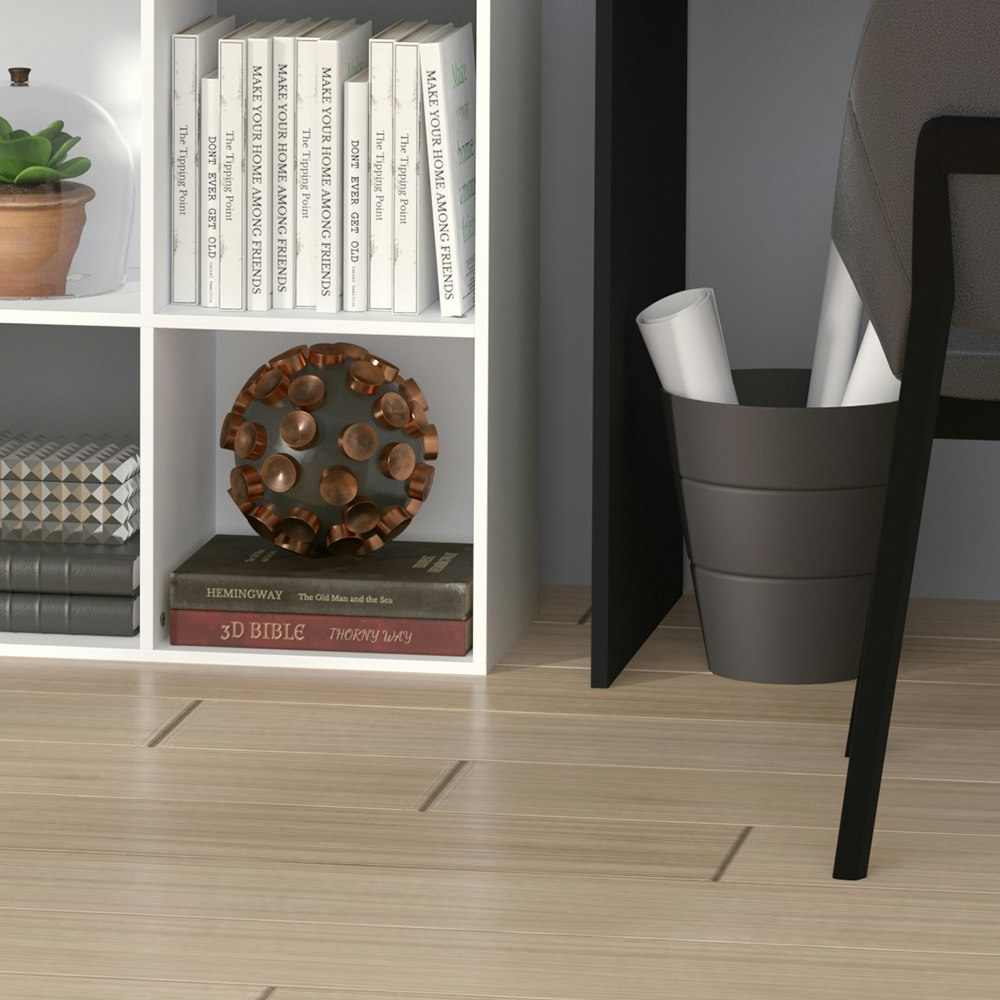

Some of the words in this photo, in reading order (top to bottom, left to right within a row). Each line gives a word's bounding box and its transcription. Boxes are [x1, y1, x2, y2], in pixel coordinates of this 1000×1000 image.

[252, 66, 263, 103] MAKE
[278, 64, 288, 101] MAKE
[321, 67, 332, 104] MAKE
[426, 70, 439, 107] MAKE
[179, 125, 188, 145] The
[251, 105, 262, 142] YOUR
[277, 103, 288, 140] YOUR
[302, 128, 311, 148] The
[321, 106, 332, 143] YOUR
[376, 130, 385, 150] The
[430, 109, 442, 147] YOUR
[208, 136, 217, 165] DONT
[226, 131, 235, 150] The
[351, 140, 360, 169] DONT
[400, 134, 410, 154] The
[178, 147, 188, 188] Tipping
[223, 153, 234, 193] Tipping
[252, 144, 262, 185] HOME
[277, 142, 287, 183] HOME
[299, 151, 311, 191] Tipping
[321, 146, 332, 187] HOME
[373, 153, 385, 193] Tipping
[397, 156, 409, 197] Tipping
[433, 150, 446, 190] HOME
[179, 190, 188, 215] Point
[208, 172, 217, 201] EVER
[351, 176, 360, 205] EVER
[208, 208, 217, 230] GET
[226, 196, 234, 221] Point
[252, 187, 262, 237] AMONG
[277, 185, 287, 235] AMONG
[302, 194, 311, 219] Point
[321, 189, 331, 239] AMONG
[351, 212, 360, 234] GET
[376, 195, 384, 221] Point
[400, 199, 409, 225] Point
[436, 193, 450, 242] AMONG
[208, 237, 217, 259] OLD
[277, 238, 287, 293] FRIENDS
[351, 241, 360, 263] OLD
[251, 240, 262, 295] FRIENDS
[321, 242, 331, 297] FRIENDS
[441, 246, 454, 300] FRIENDS
[206, 587, 283, 600] HEMINGWAY
[298, 592, 314, 601] The
[315, 593, 330, 602] Old
[331, 594, 349, 603] Man
[350, 595, 365, 603] and
[366, 595, 379, 604] the
[380, 596, 393, 604] Sea
[220, 621, 245, 641] 3D
[250, 621, 306, 641] BIBLE
[329, 626, 380, 643] THORNY
[382, 629, 413, 644] WAY
